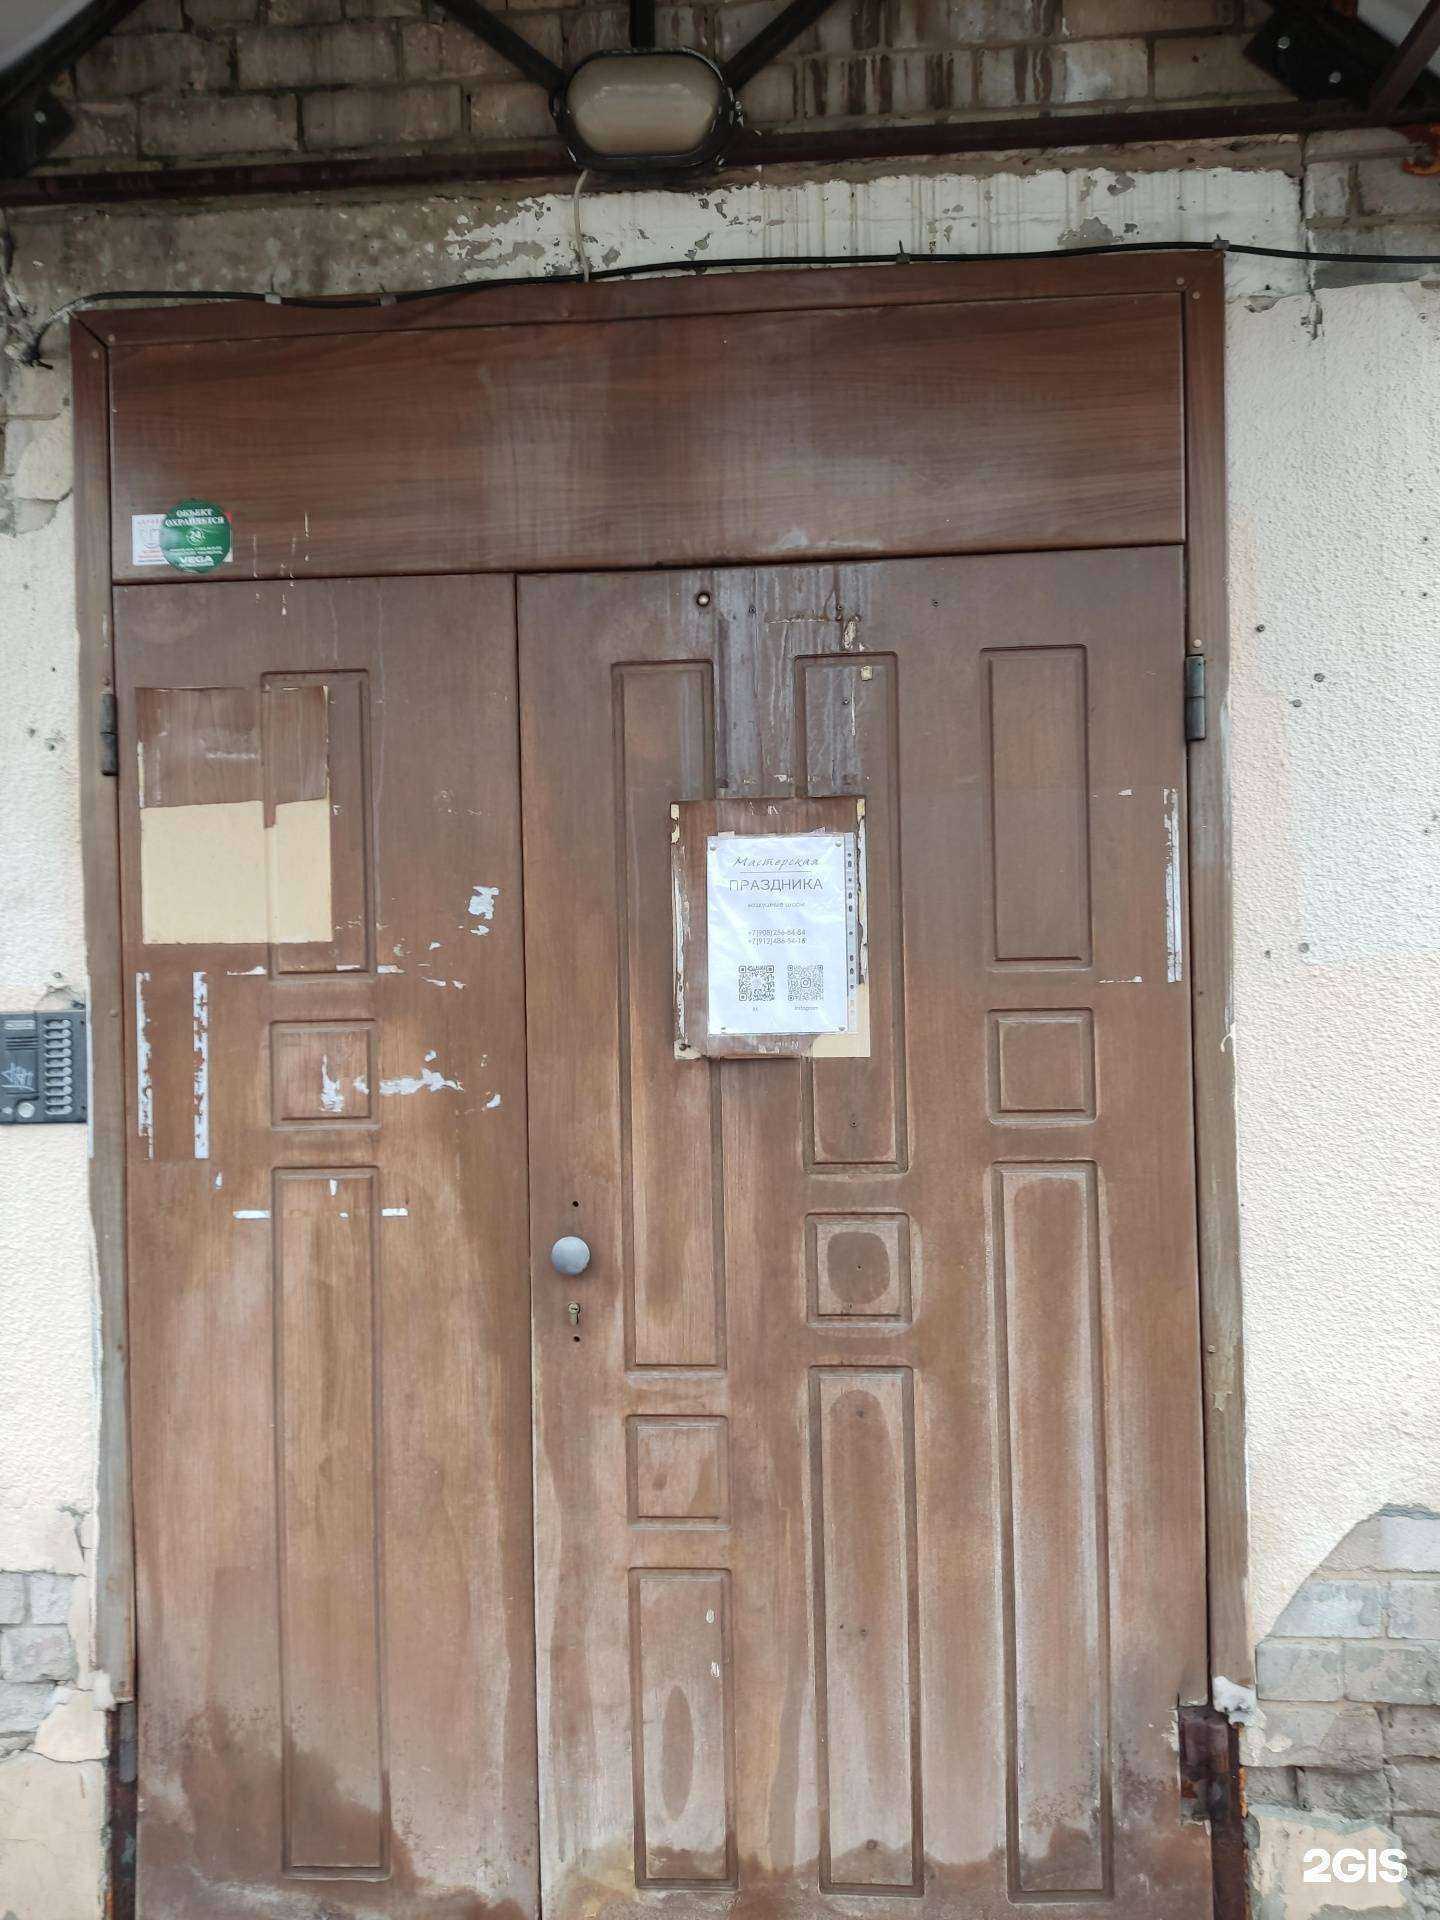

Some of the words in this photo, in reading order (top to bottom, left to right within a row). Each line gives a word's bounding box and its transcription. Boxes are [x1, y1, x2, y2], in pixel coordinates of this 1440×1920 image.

[165, 516, 225, 527] ОХРАНЯЕТСЯ
[733, 855, 819, 871] Мастерская
[729, 878, 824, 892] ПРАЗДНИКА
